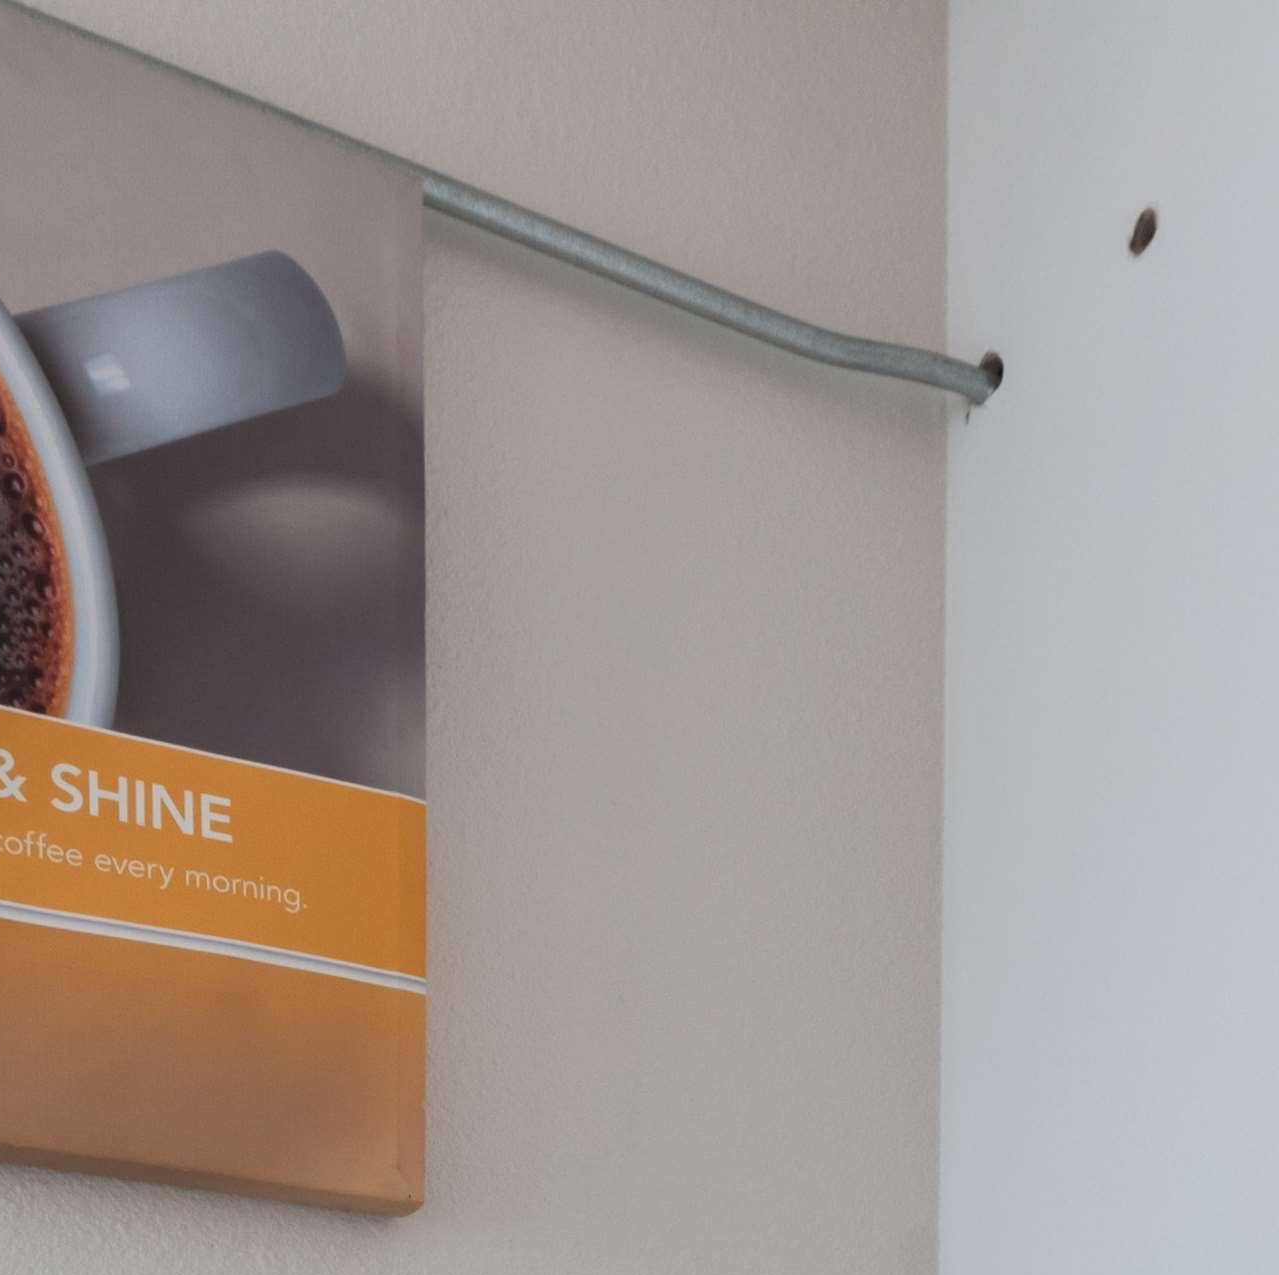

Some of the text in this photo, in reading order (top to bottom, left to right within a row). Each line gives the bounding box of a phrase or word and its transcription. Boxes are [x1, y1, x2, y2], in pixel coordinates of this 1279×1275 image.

[49, 761, 235, 844] SHINE
[93, 853, 175, 890] every
[184, 869, 308, 914] morning.
